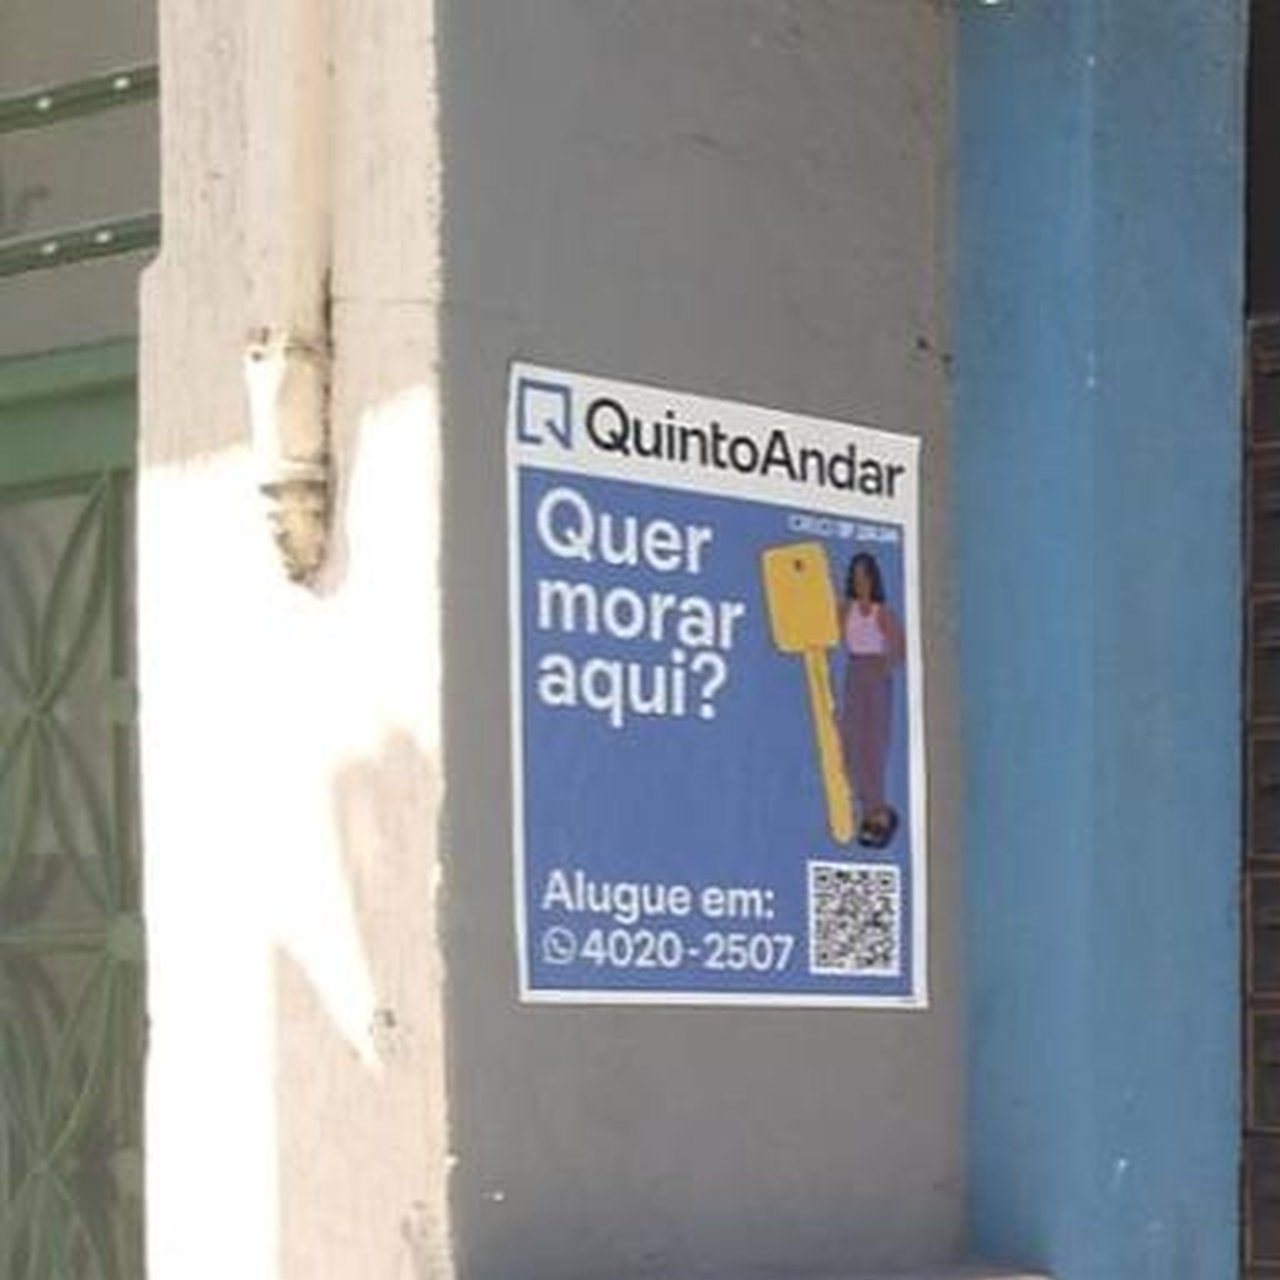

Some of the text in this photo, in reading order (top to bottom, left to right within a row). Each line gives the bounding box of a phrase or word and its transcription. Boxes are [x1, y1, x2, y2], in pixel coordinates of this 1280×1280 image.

[585, 398, 906, 498] QuintoAndar
[536, 487, 713, 573] Quer
[536, 579, 746, 649] morar
[537, 650, 727, 728] aqui?
[541, 869, 776, 924] Alugue em:
